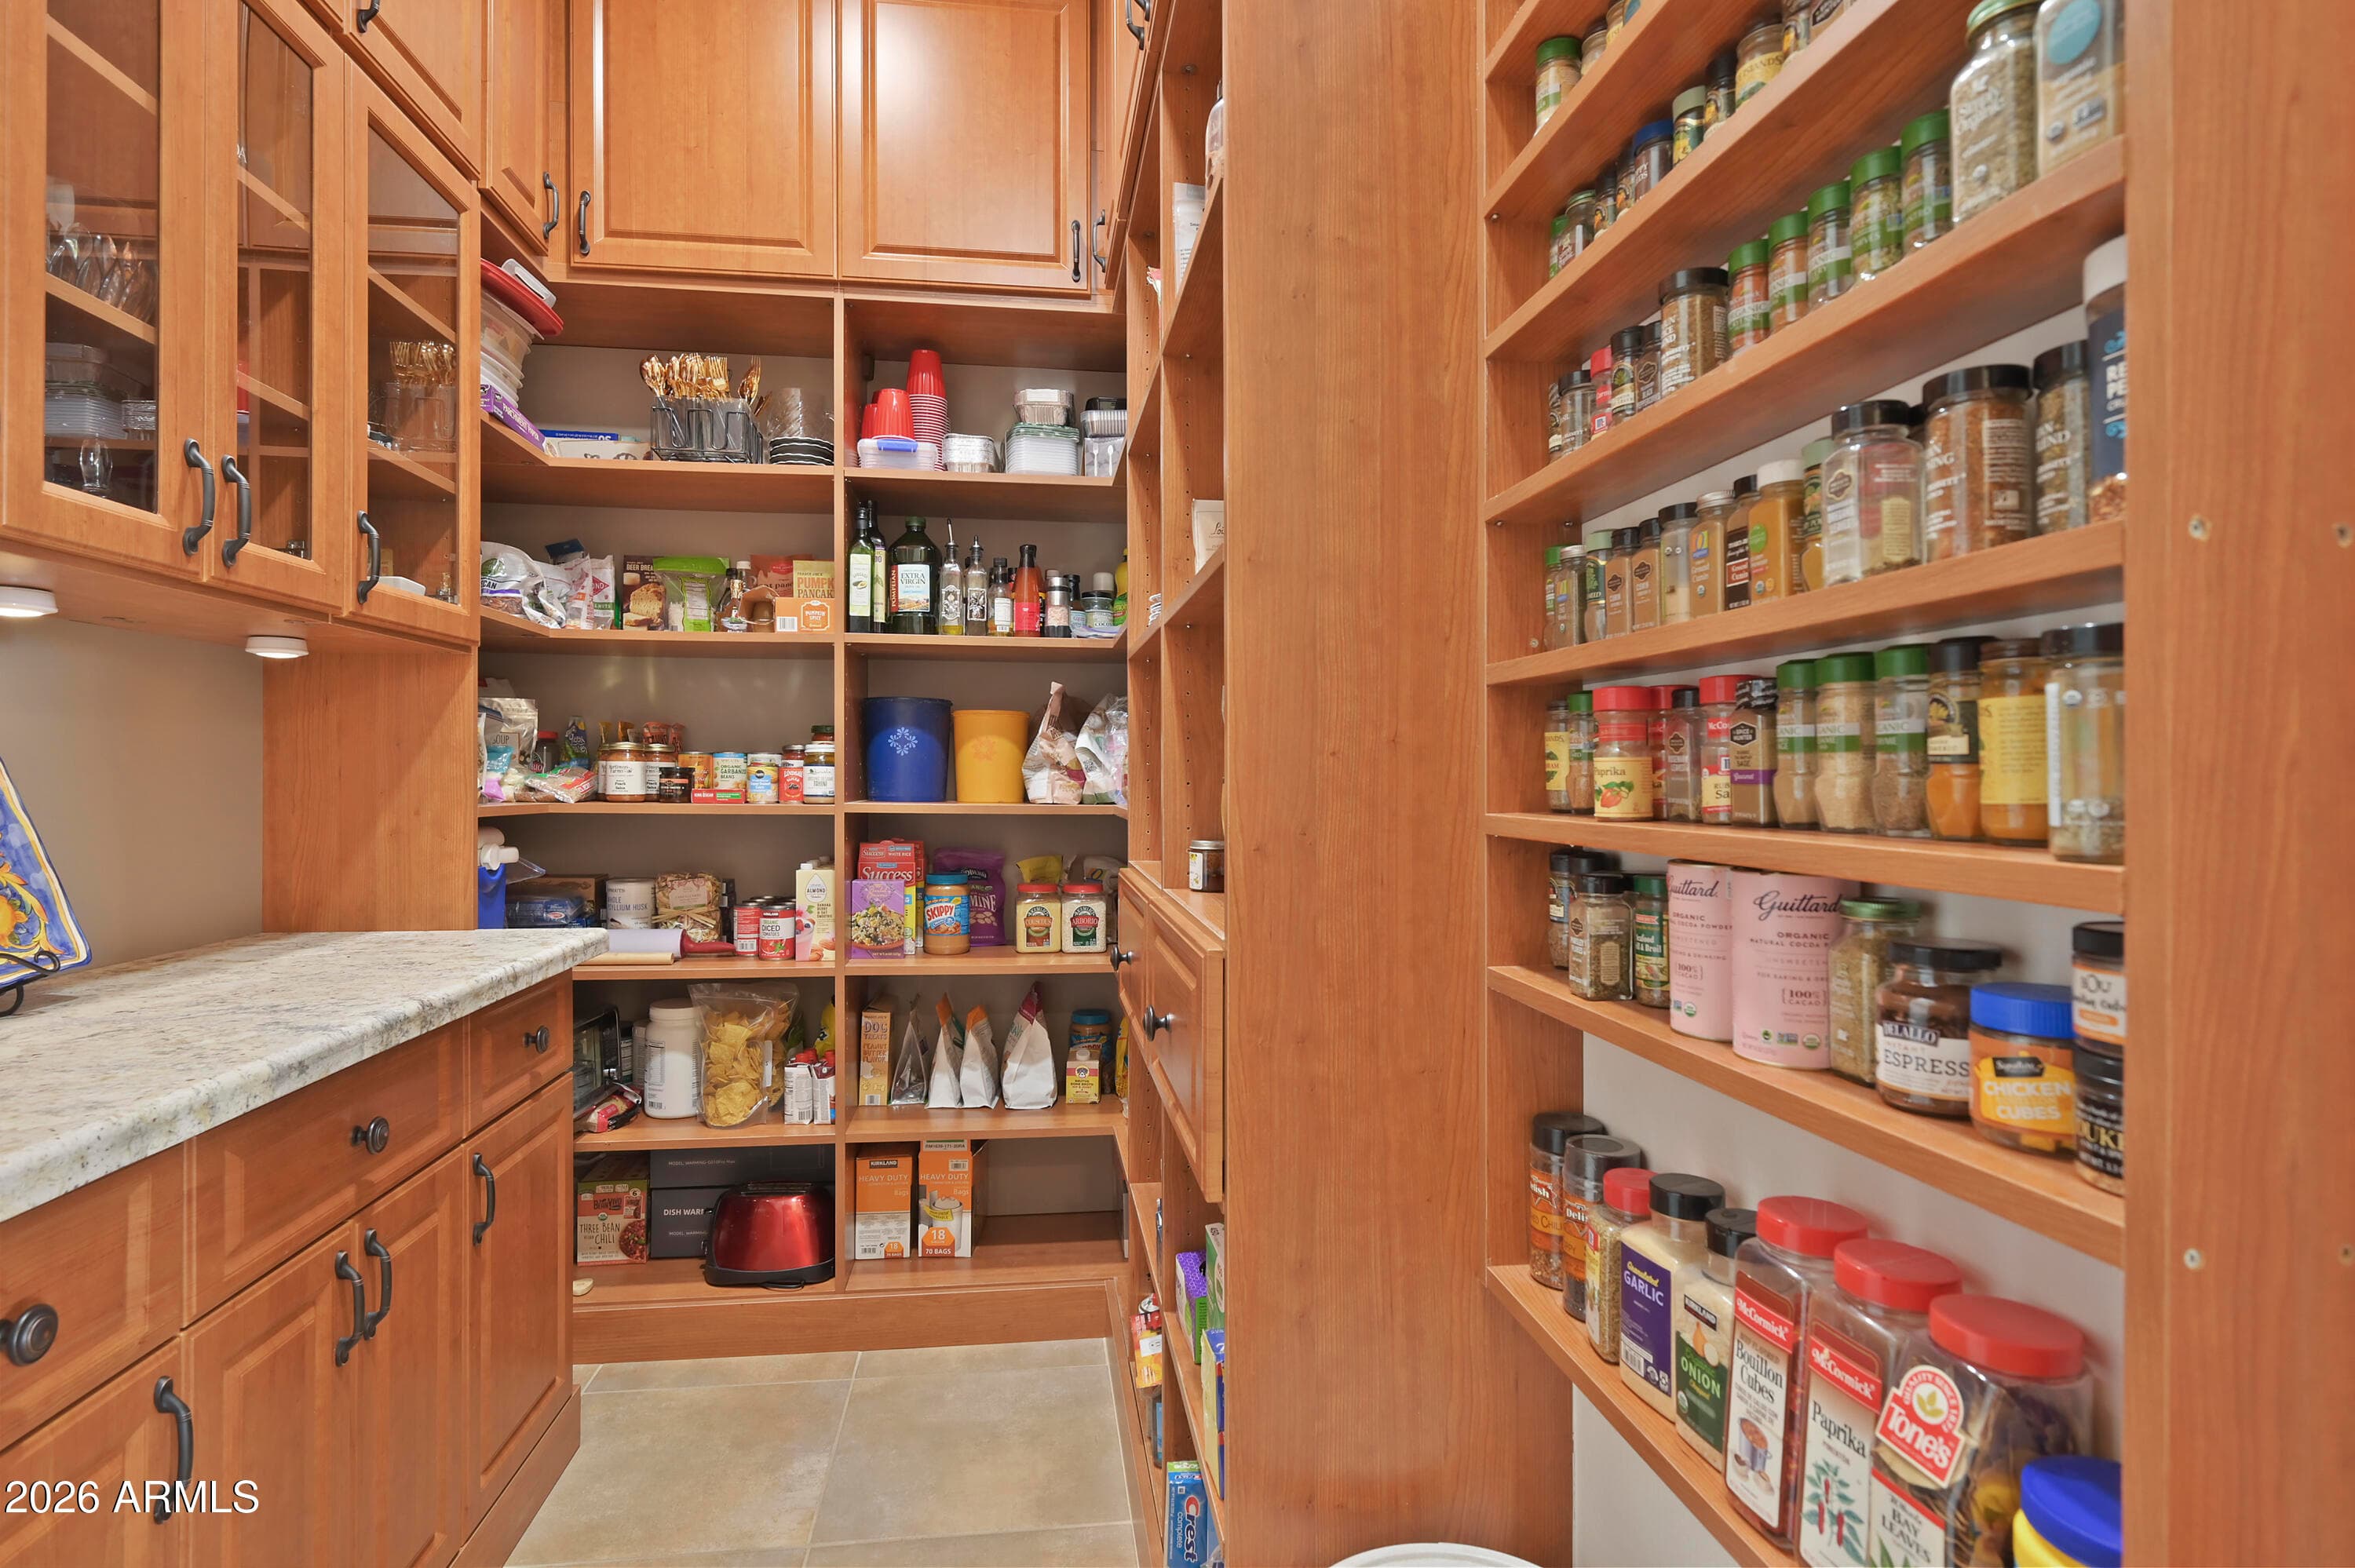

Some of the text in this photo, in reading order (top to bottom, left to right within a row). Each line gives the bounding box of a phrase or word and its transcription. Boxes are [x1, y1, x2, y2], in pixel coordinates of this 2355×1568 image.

[502, 403, 540, 442] PARCHMENT PAPER
[480, 580, 497, 589] CAN
[798, 578, 834, 589] PUMPK
[798, 589, 834, 598] PANCAK
[492, 735, 509, 745] SOUP
[1594, 765, 1627, 777] Paprika
[1715, 789, 1730, 799] Sa
[862, 867, 912, 881] Success
[970, 895, 997, 912] MINE
[1753, 890, 1841, 921] Guittard
[926, 905, 955, 921] SKIPPY
[1637, 934, 1655, 943] eafood
[1750, 938, 1784, 946] NATURAL
[1648, 943, 1662, 954] Broil
[864, 1022, 887, 1033] DOG
[1884, 1023, 1937, 1042] DELALLO
[1885, 1049, 1970, 1078] ESPRESS
[1984, 1081, 2071, 1096] CHICKEN
[1997, 1106, 2061, 1120] CUBES
[580, 1223, 620, 1234] THREE BEAN
[932, 1230, 945, 1240] 18
[595, 1233, 615, 1245] CHILI
[1623, 1270, 1664, 1307] GARLIC
[1736, 1297, 1787, 1341] McCormick
[1736, 1339, 1784, 1389] Bouillon
[1681, 1356, 1721, 1399] ONION
[1812, 1347, 1873, 1400] McCormick
[1740, 1365, 1775, 1404] Cubes
[1812, 1400, 1866, 1458] Paprika
[1185, 1495, 1200, 1563] Crest
[1893, 1508, 1918, 1537] BAY
[1882, 1515, 1930, 1563] LEAVES
